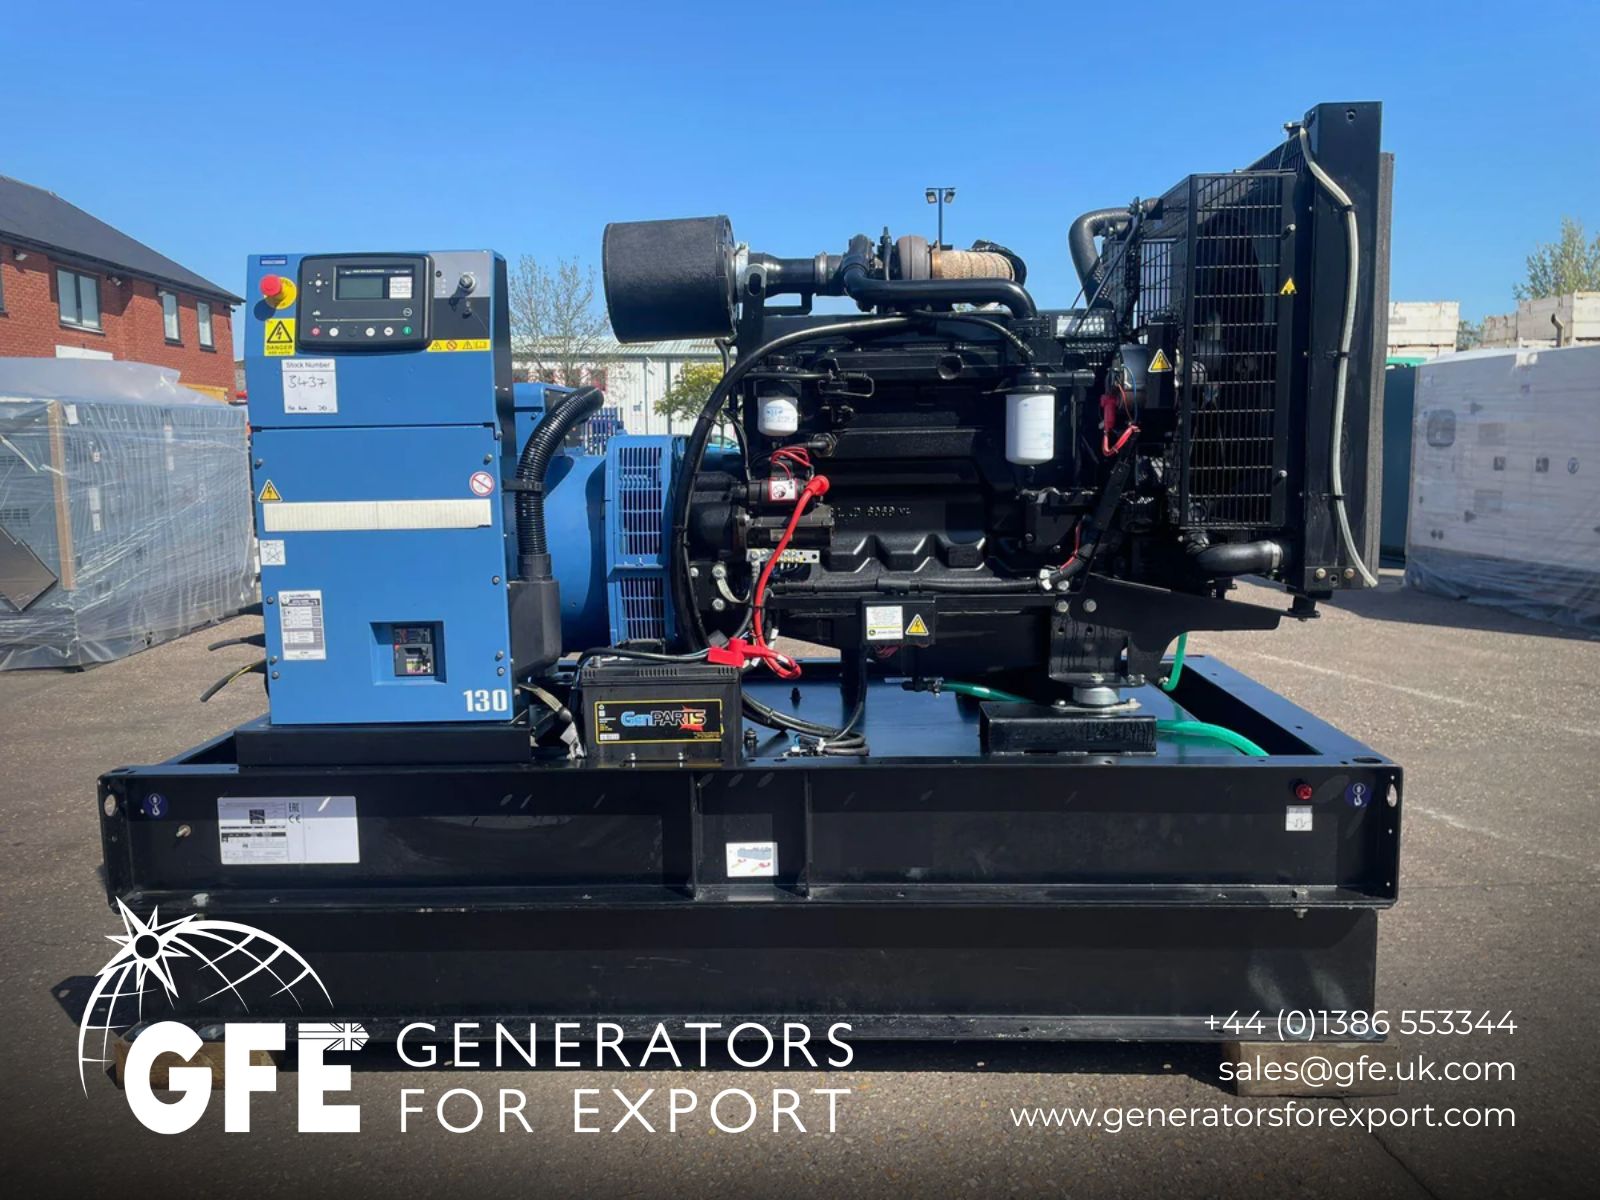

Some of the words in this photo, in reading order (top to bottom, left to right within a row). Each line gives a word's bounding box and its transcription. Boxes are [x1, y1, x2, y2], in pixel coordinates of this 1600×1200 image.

[286, 361, 304, 369] Stock
[305, 361, 331, 369] Number
[288, 375, 327, 389] 3437
[464, 689, 507, 712] 130
